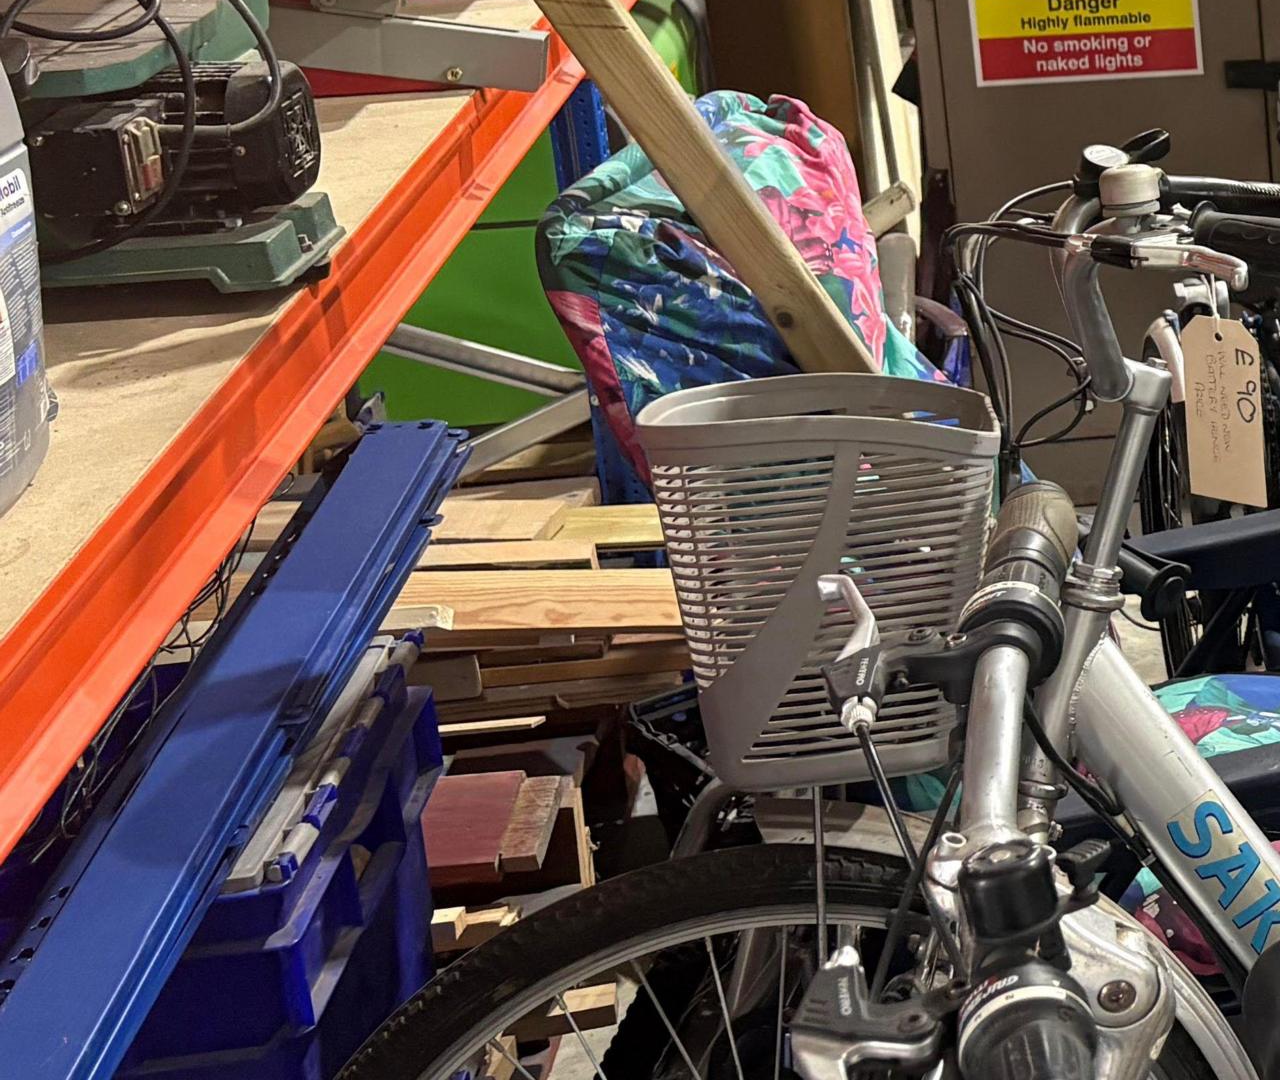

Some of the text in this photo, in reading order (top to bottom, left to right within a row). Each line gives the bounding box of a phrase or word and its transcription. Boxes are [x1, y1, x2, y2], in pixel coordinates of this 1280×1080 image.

[1020, 12, 1152, 32] Highly flammable
[1023, 35, 1152, 54] No smoking or
[1036, 52, 1144, 73] naked lights
